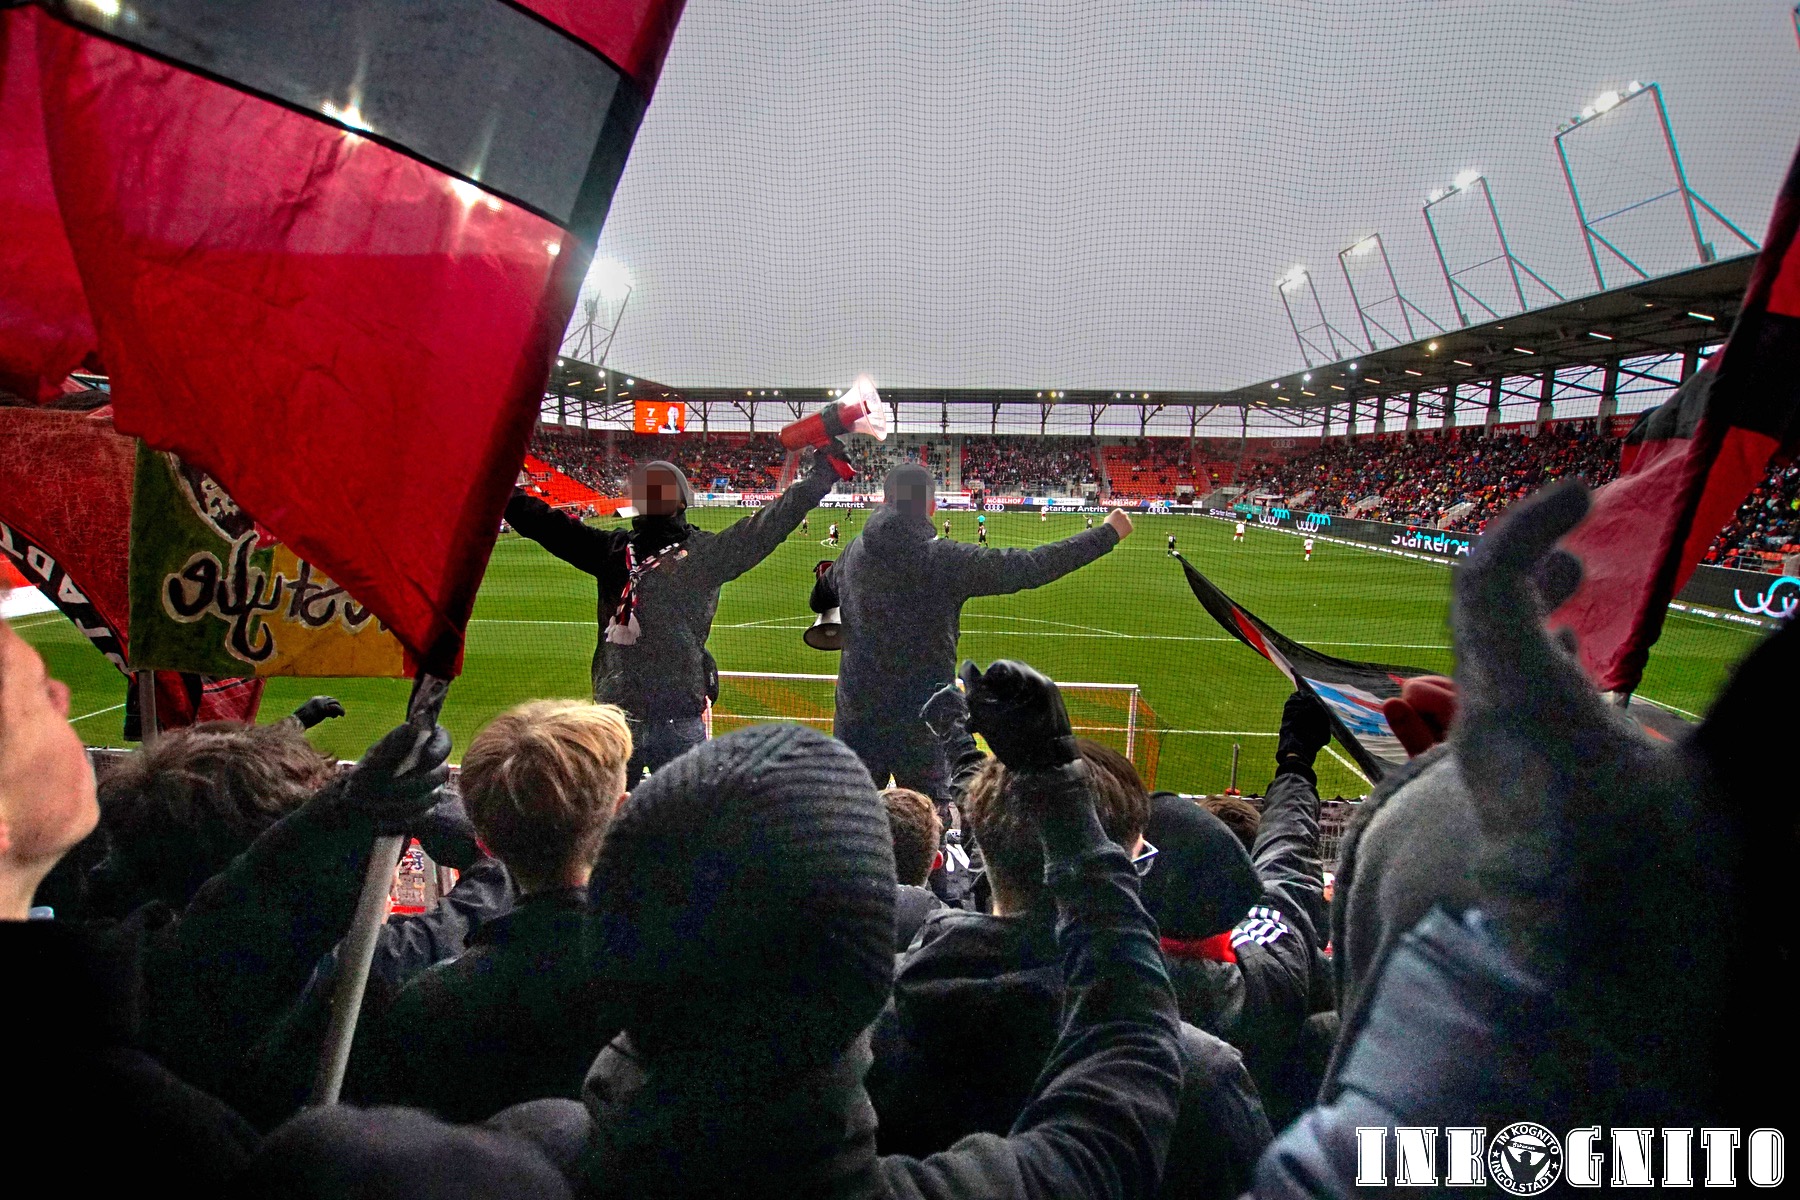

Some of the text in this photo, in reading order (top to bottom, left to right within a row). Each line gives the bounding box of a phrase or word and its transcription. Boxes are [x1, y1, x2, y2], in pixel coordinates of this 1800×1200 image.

[646, 407, 656, 417] 7
[986, 496, 1021, 504] MÖBELHOF
[834, 501, 865, 509] Antritt
[1077, 505, 1108, 513] Antritt
